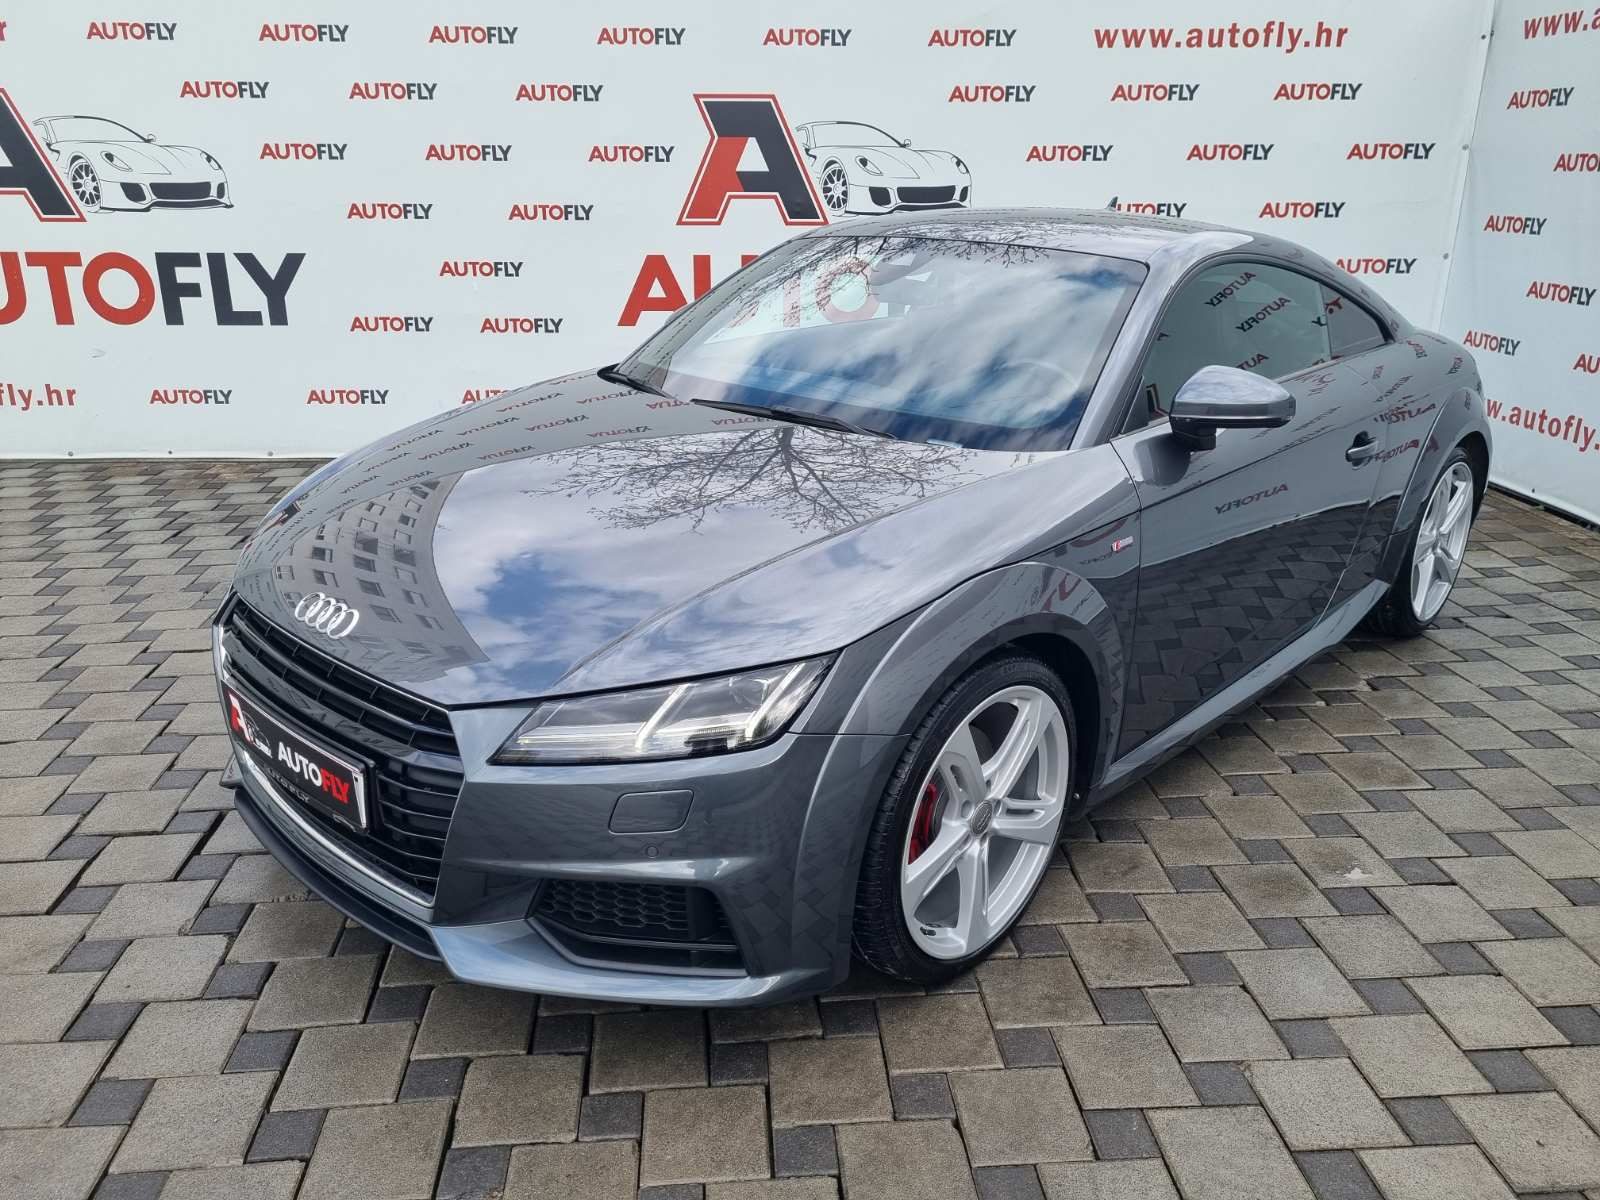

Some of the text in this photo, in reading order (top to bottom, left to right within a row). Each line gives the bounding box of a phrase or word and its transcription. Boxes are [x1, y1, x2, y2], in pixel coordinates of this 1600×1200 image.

[87, 22, 177, 40] AUTOFLY
[259, 24, 349, 42] AUTOFLY
[429, 26, 518, 44] AUTOFLY
[597, 28, 686, 45] AUTOFLY
[763, 29, 852, 47] AUTOFLY
[928, 29, 1016, 47] AUTOFLY
[1094, 21, 1348, 54] www.autofly.hr
[180, 81, 269, 98] AUTOFLY
[349, 83, 437, 100] AUTOFLY
[515, 84, 603, 102] AUTOFLY
[949, 85, 1036, 102] AUTOFLY
[1111, 84, 1200, 101] AUTOFLY
[1274, 83, 1363, 100] AUTOFLY
[1507, 87, 1574, 109] AUTOFLY
[260, 143, 347, 161] AUTOFLY
[425, 144, 512, 161] AUTOFLY
[588, 146, 674, 162] AUTOFLY
[1026, 145, 1113, 162] AUTOFLY
[1186, 144, 1274, 161] AUTOFLY
[1347, 143, 1436, 160] AUTOFLY
[347, 203, 432, 220] AUTOFLY
[508, 205, 594, 221] AUTOFLY
[1117, 203, 1187, 218] UTOFLY
[1259, 202, 1346, 218] AUTOFLY
[1484, 215, 1547, 235] AUTOFLY
[440, 261, 523, 277] AUTOFLY
[1526, 281, 1597, 306] AUTOFLY
[350, 317, 433, 332] AUTOFLY
[480, 318, 563, 333] AUTOFLY
[1464, 330, 1521, 356] AUTOFLY
[150, 390, 232, 405] AUTOFLY
[307, 390, 389, 405] AUTOFLY
[277, 741, 350, 805] AUTOFLY
